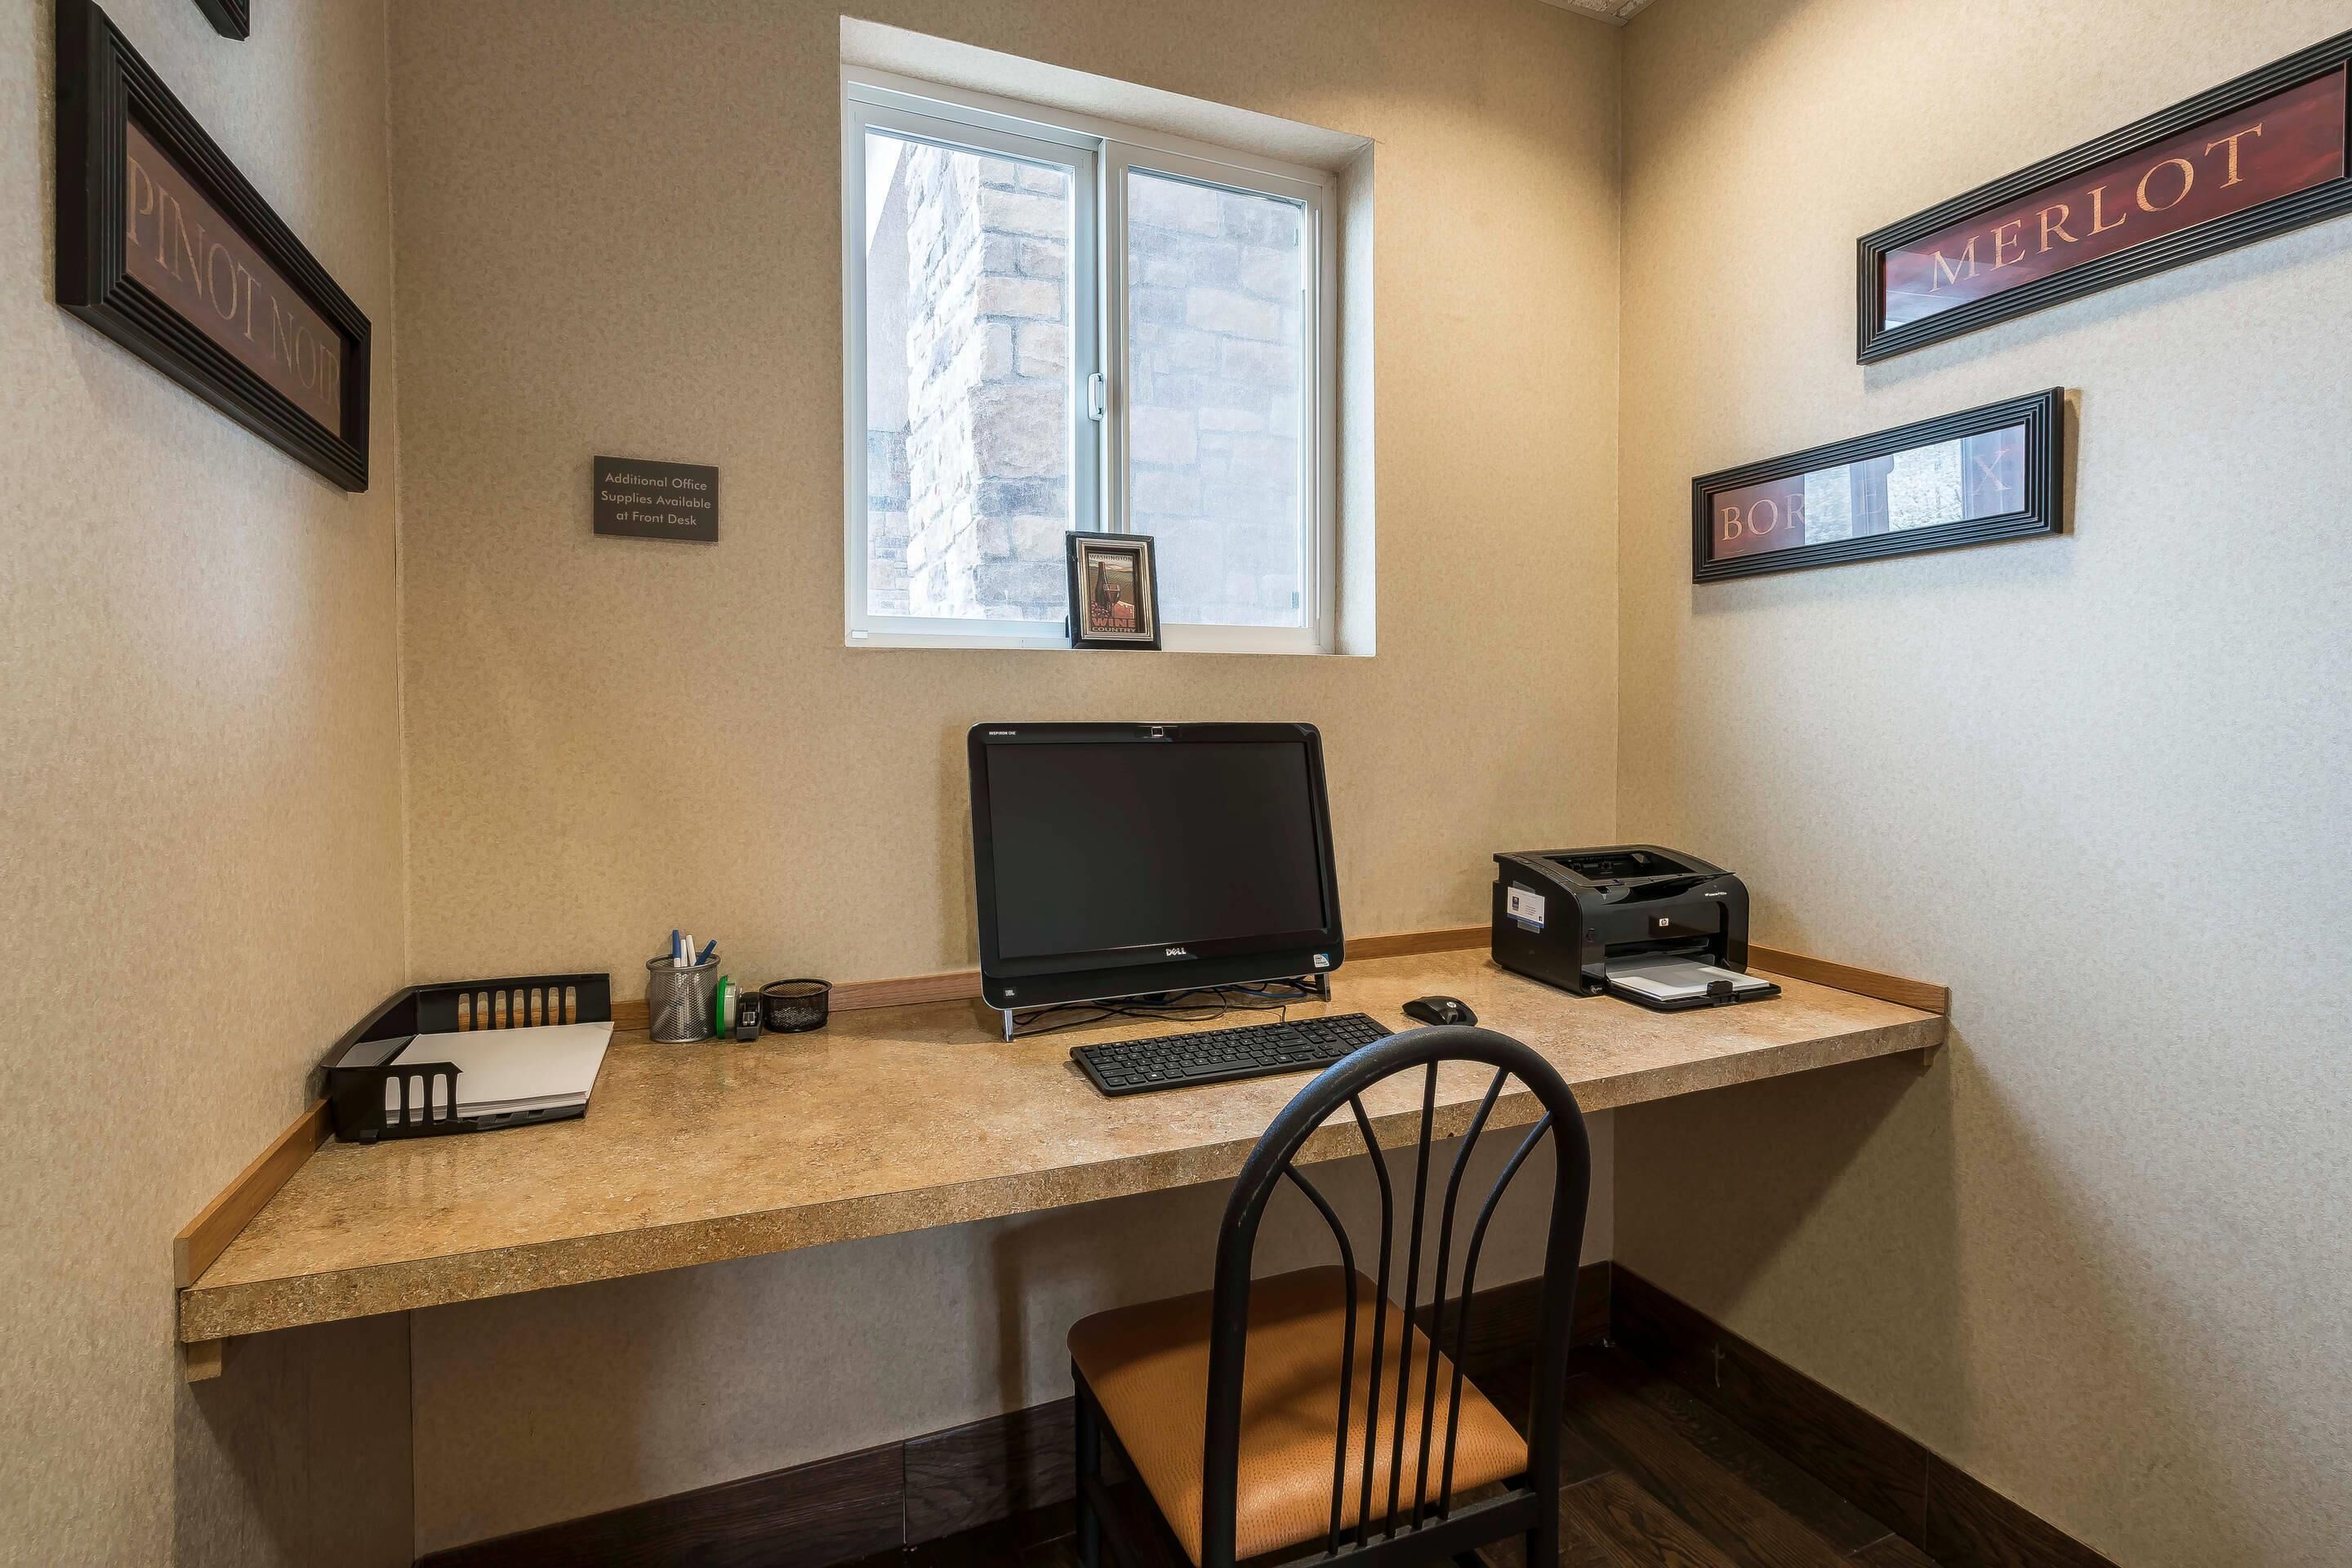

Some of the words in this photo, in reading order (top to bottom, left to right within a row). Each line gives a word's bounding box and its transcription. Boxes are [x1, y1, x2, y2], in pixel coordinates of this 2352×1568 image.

[1929, 122, 2262, 294] MERLOT
[127, 156, 261, 341] PINOT
[270, 296, 341, 409] NOIR
[605, 473, 667, 488] Additional
[671, 478, 707, 490] Office
[601, 490, 653, 505] Supplies
[656, 496, 711, 509] Available
[616, 511, 628, 520] at
[633, 511, 664, 523] Front
[668, 514, 697, 526] Desk
[1091, 617, 1135, 628] WINE
[1165, 947, 1187, 956] DELL
